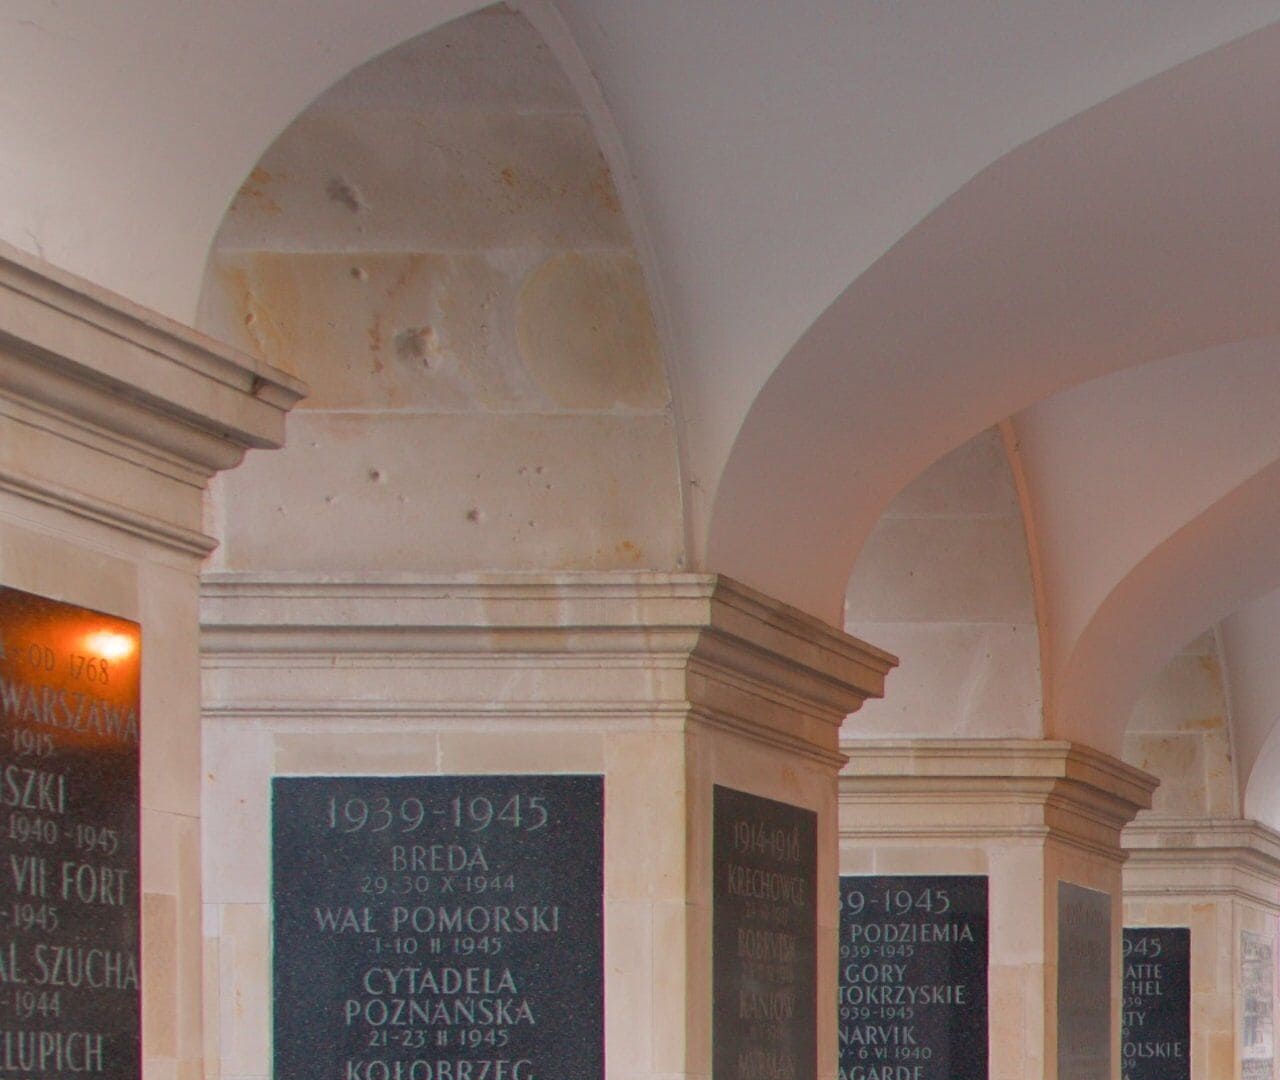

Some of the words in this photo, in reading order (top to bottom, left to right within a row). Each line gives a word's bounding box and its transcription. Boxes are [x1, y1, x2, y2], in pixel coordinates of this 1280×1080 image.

[70, 654, 109, 685] 1768
[392, 846, 489, 871] BREDA
[63, 862, 129, 905] FORT
[466, 876, 515, 893] 1944
[316, 907, 376, 932] WAŁ
[393, 907, 558, 932] POMORSKI
[454, 937, 502, 954] 1945
[852, 924, 974, 942] PODZIEMIA
[35, 944, 138, 990] SZUCHA
[364, 968, 517, 994] CYTADELA
[461, 1030, 509, 1047] 1945
[895, 1047, 931, 1060] 1940
